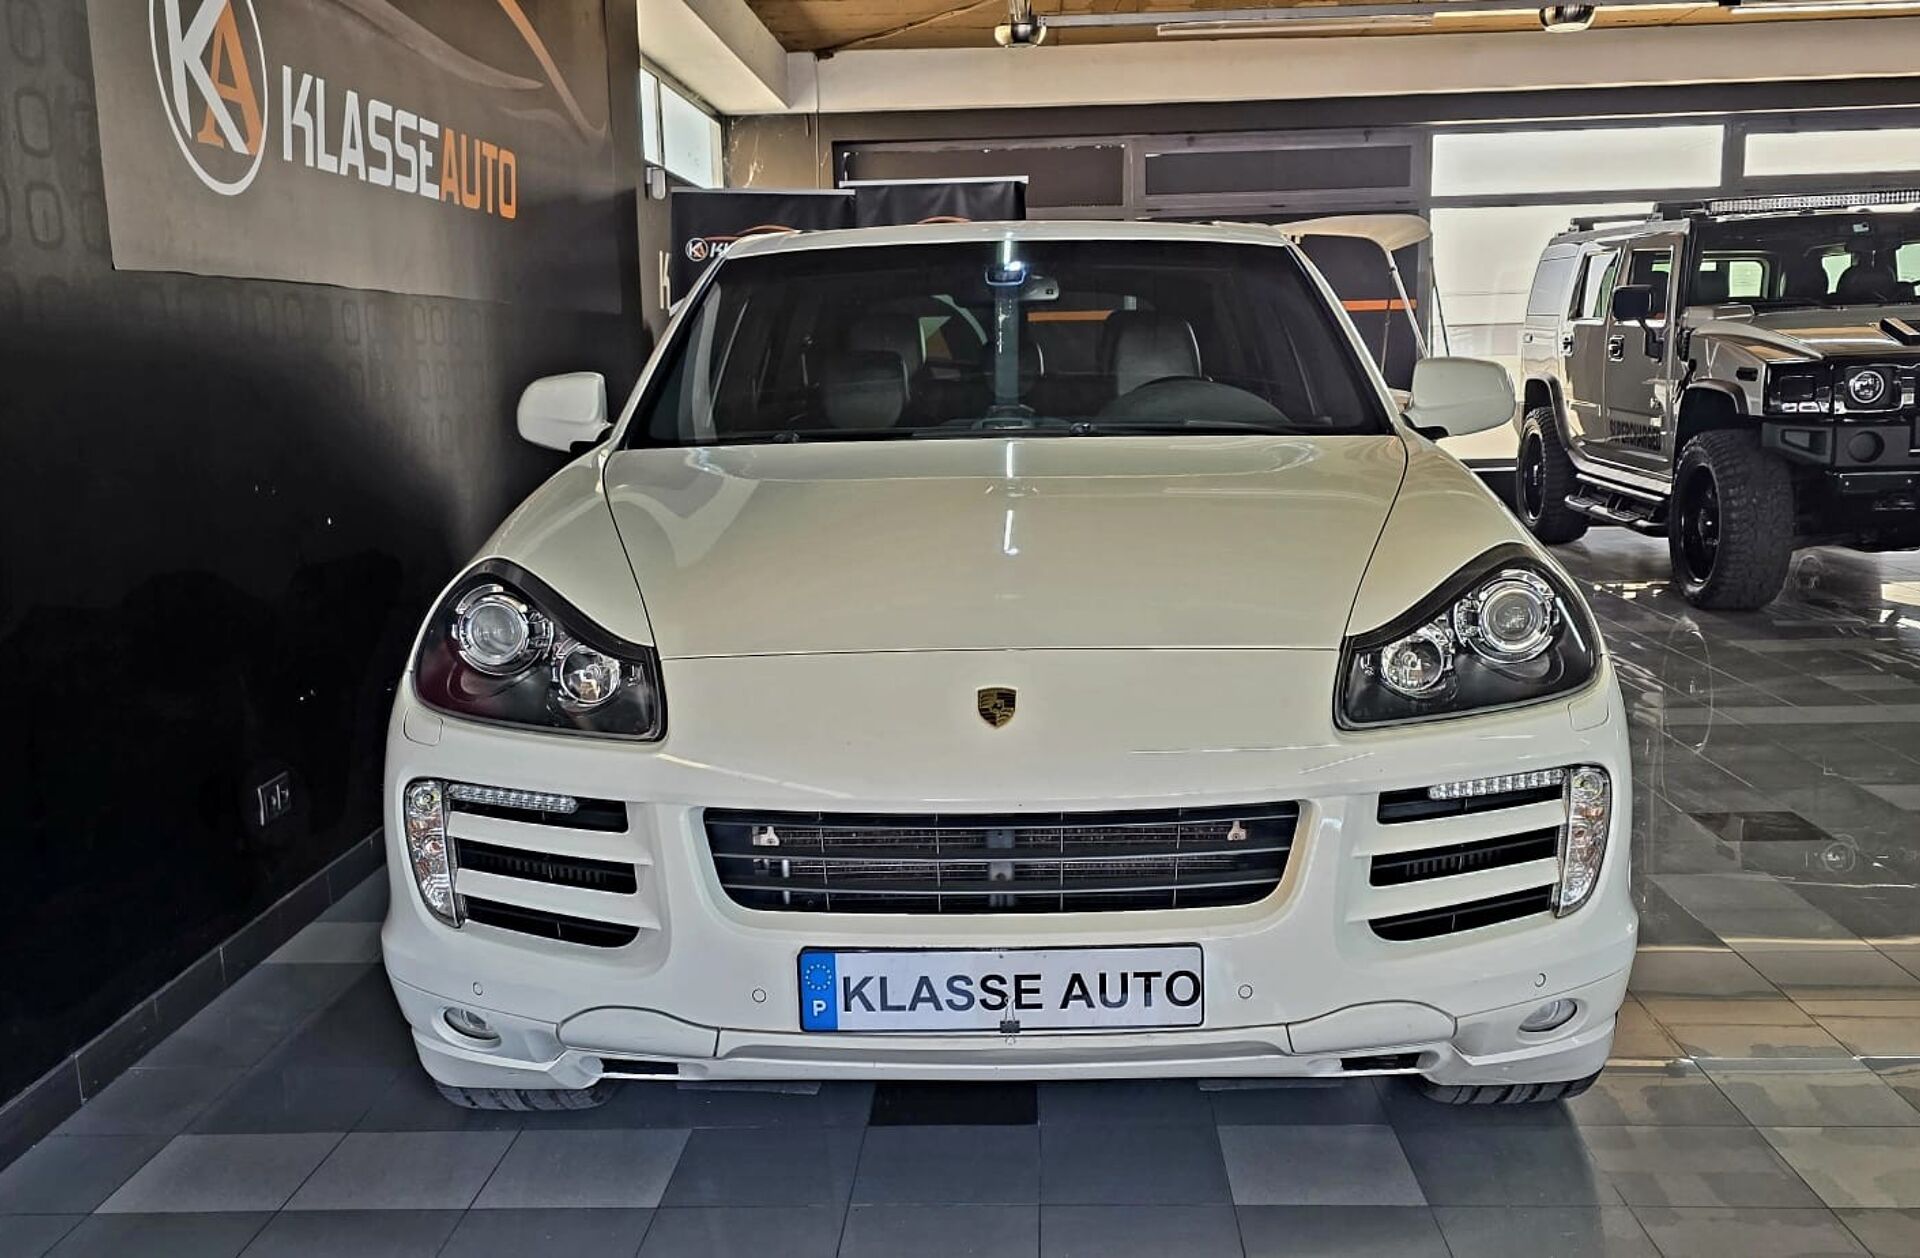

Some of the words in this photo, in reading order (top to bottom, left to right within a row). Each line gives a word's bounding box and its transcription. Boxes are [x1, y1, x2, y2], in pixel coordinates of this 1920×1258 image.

[842, 974, 1042, 1013] KLASSE
[1059, 970, 1200, 1010] AUTO
[812, 1000, 827, 1017] P
